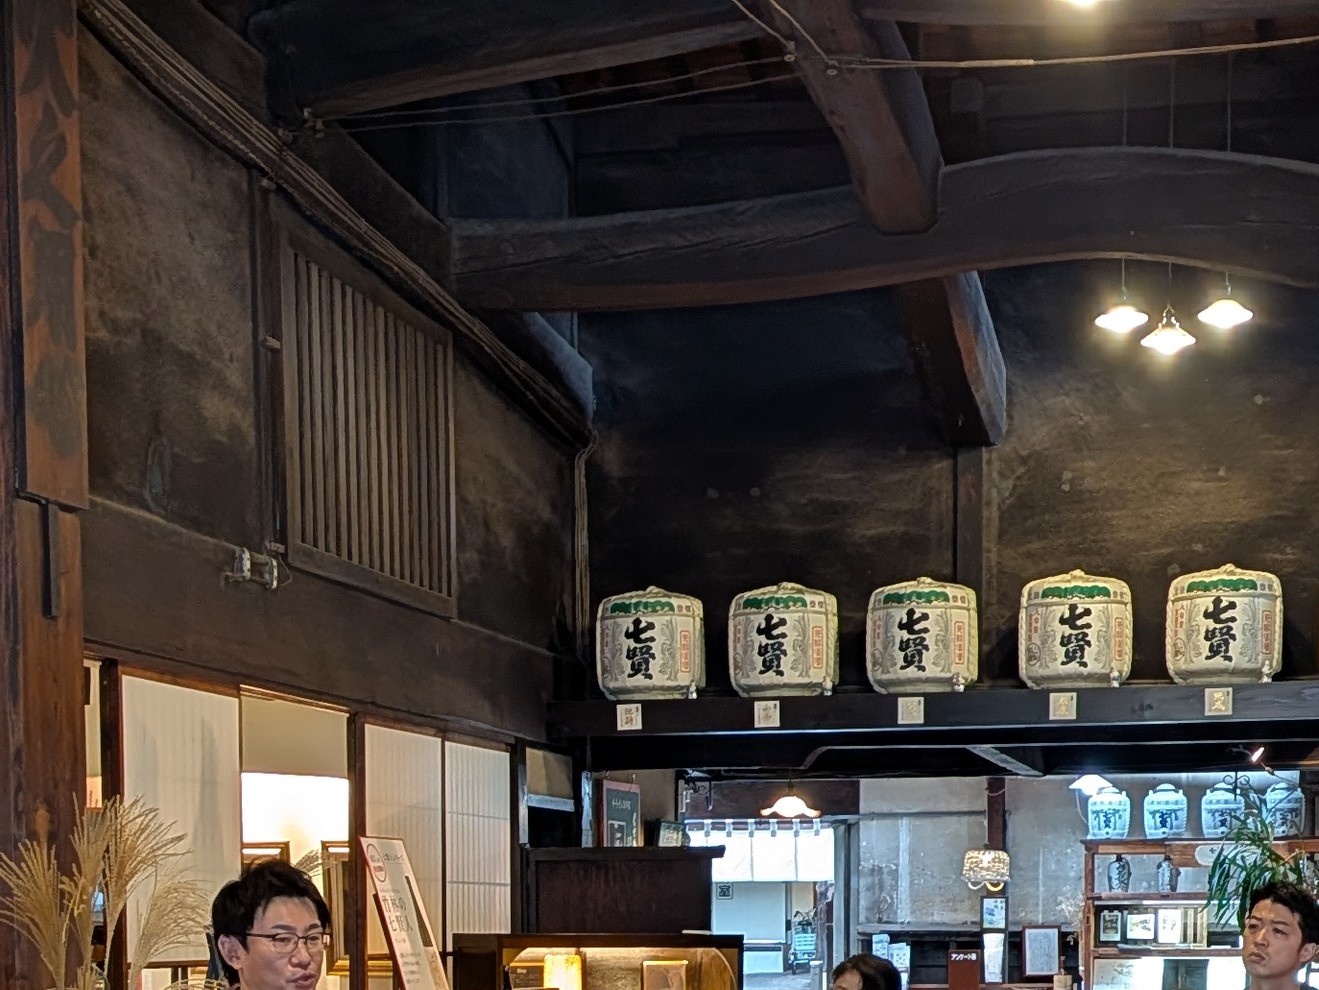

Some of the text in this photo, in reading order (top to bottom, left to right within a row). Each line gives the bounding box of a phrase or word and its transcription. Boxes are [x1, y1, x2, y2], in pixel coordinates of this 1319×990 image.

[625, 617, 656, 680] 七賢
[756, 613, 788, 678] 七賢
[898, 607, 930, 672] 七賢
[1058, 603, 1092, 668] 七賢
[1203, 595, 1237, 662] 七賢
[388, 915, 413, 933] 七賢人
